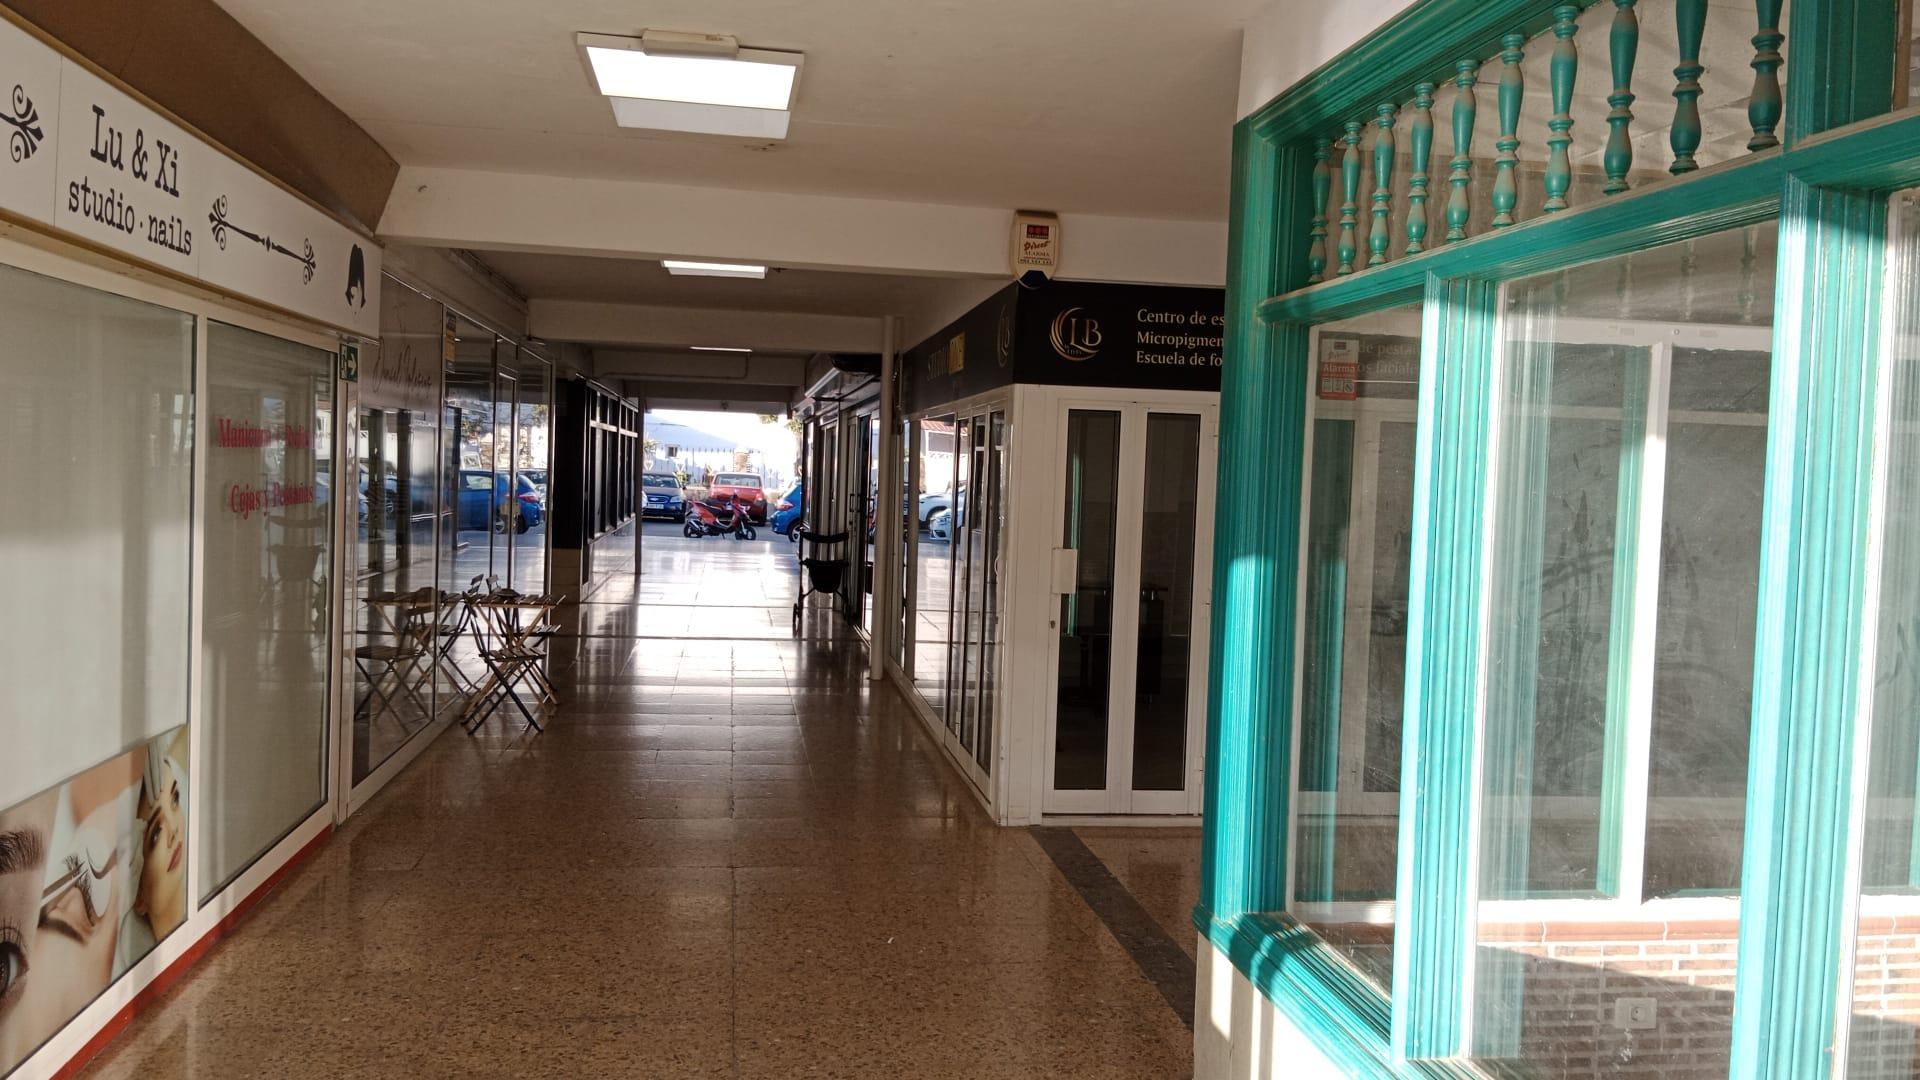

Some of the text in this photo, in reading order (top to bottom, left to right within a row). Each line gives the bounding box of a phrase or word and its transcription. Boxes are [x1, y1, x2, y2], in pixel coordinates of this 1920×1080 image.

[90, 104, 180, 198] Lu & Xi
[68, 176, 192, 256] studio nails
[1137, 308, 1185, 325] Centro
[1189, 310, 1207, 326] de
[1136, 350, 1223, 367] Escuela de fo
